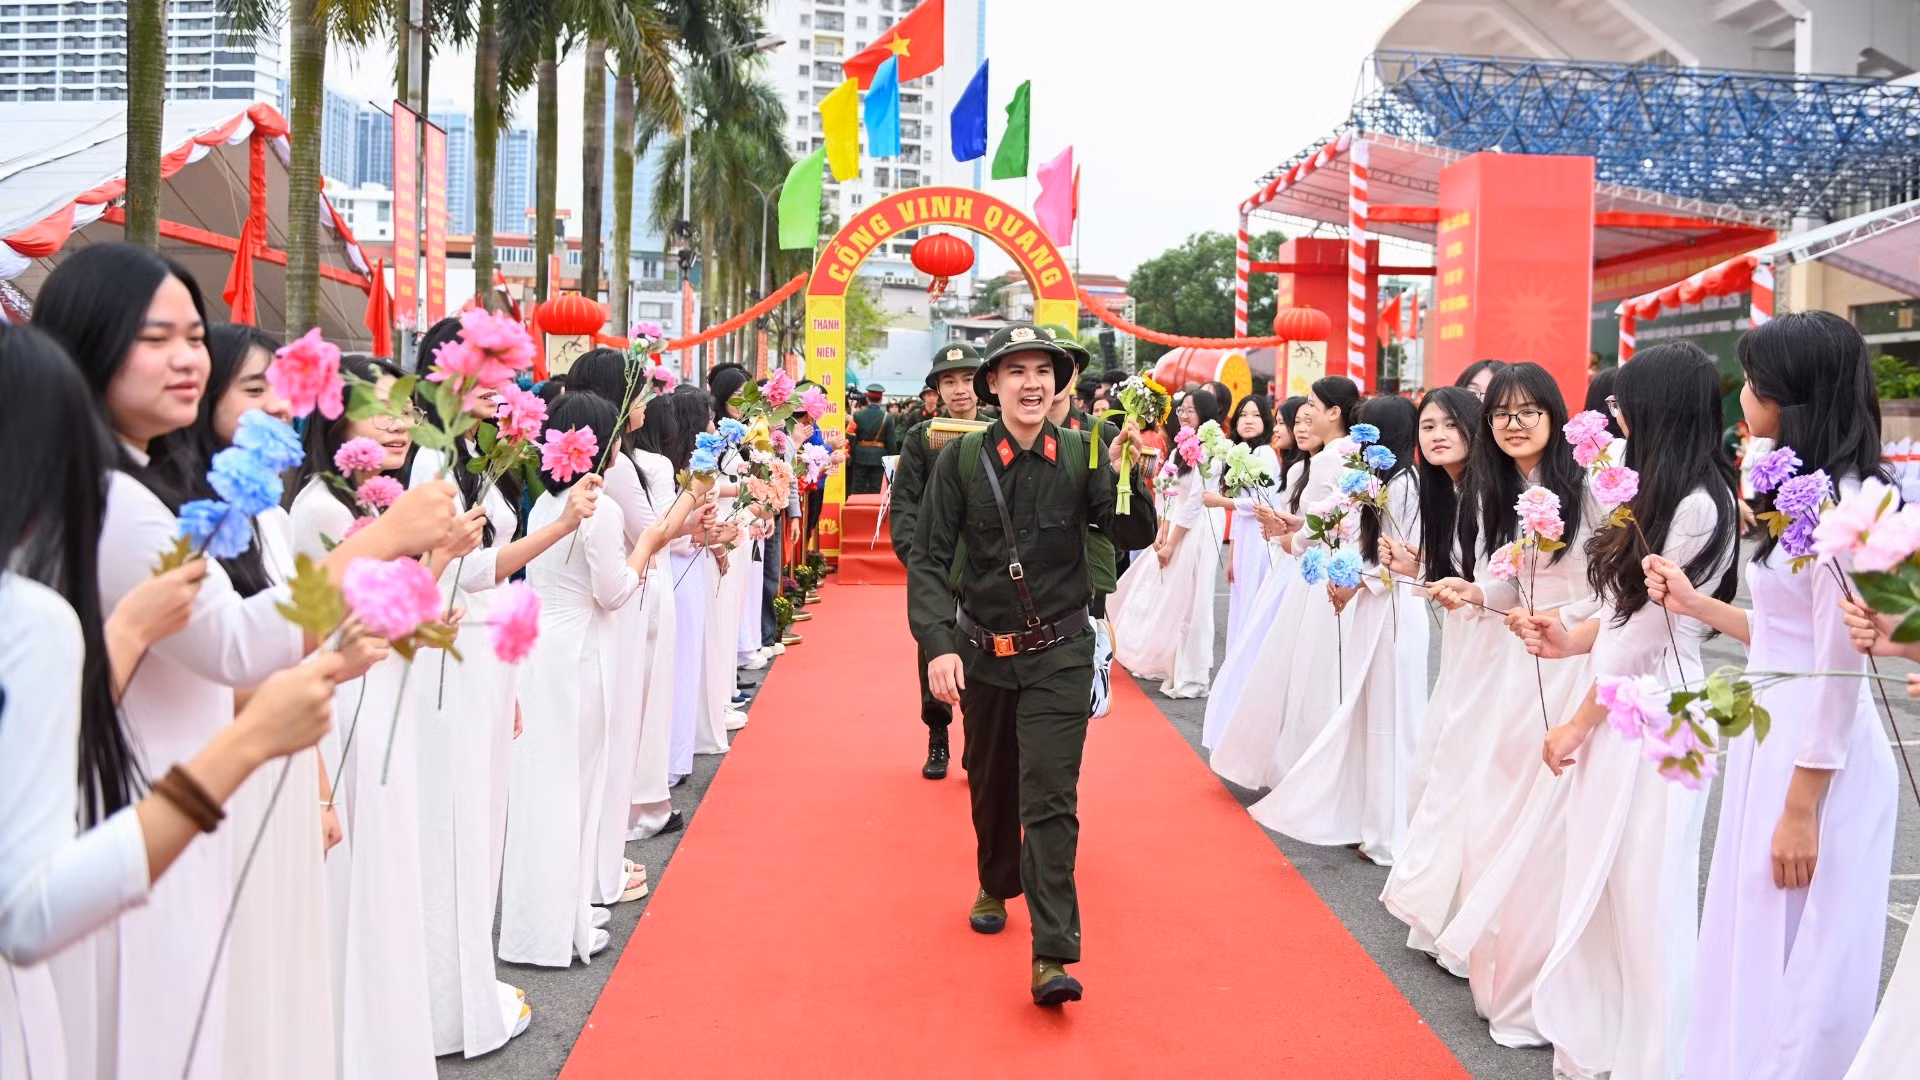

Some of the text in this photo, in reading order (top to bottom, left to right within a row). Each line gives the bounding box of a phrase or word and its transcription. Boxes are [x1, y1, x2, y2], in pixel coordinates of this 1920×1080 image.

[828, 195, 1063, 288] CỔNG VINH QUANG
[813, 319, 839, 330] THANH
[816, 345, 836, 358] NIÊN
